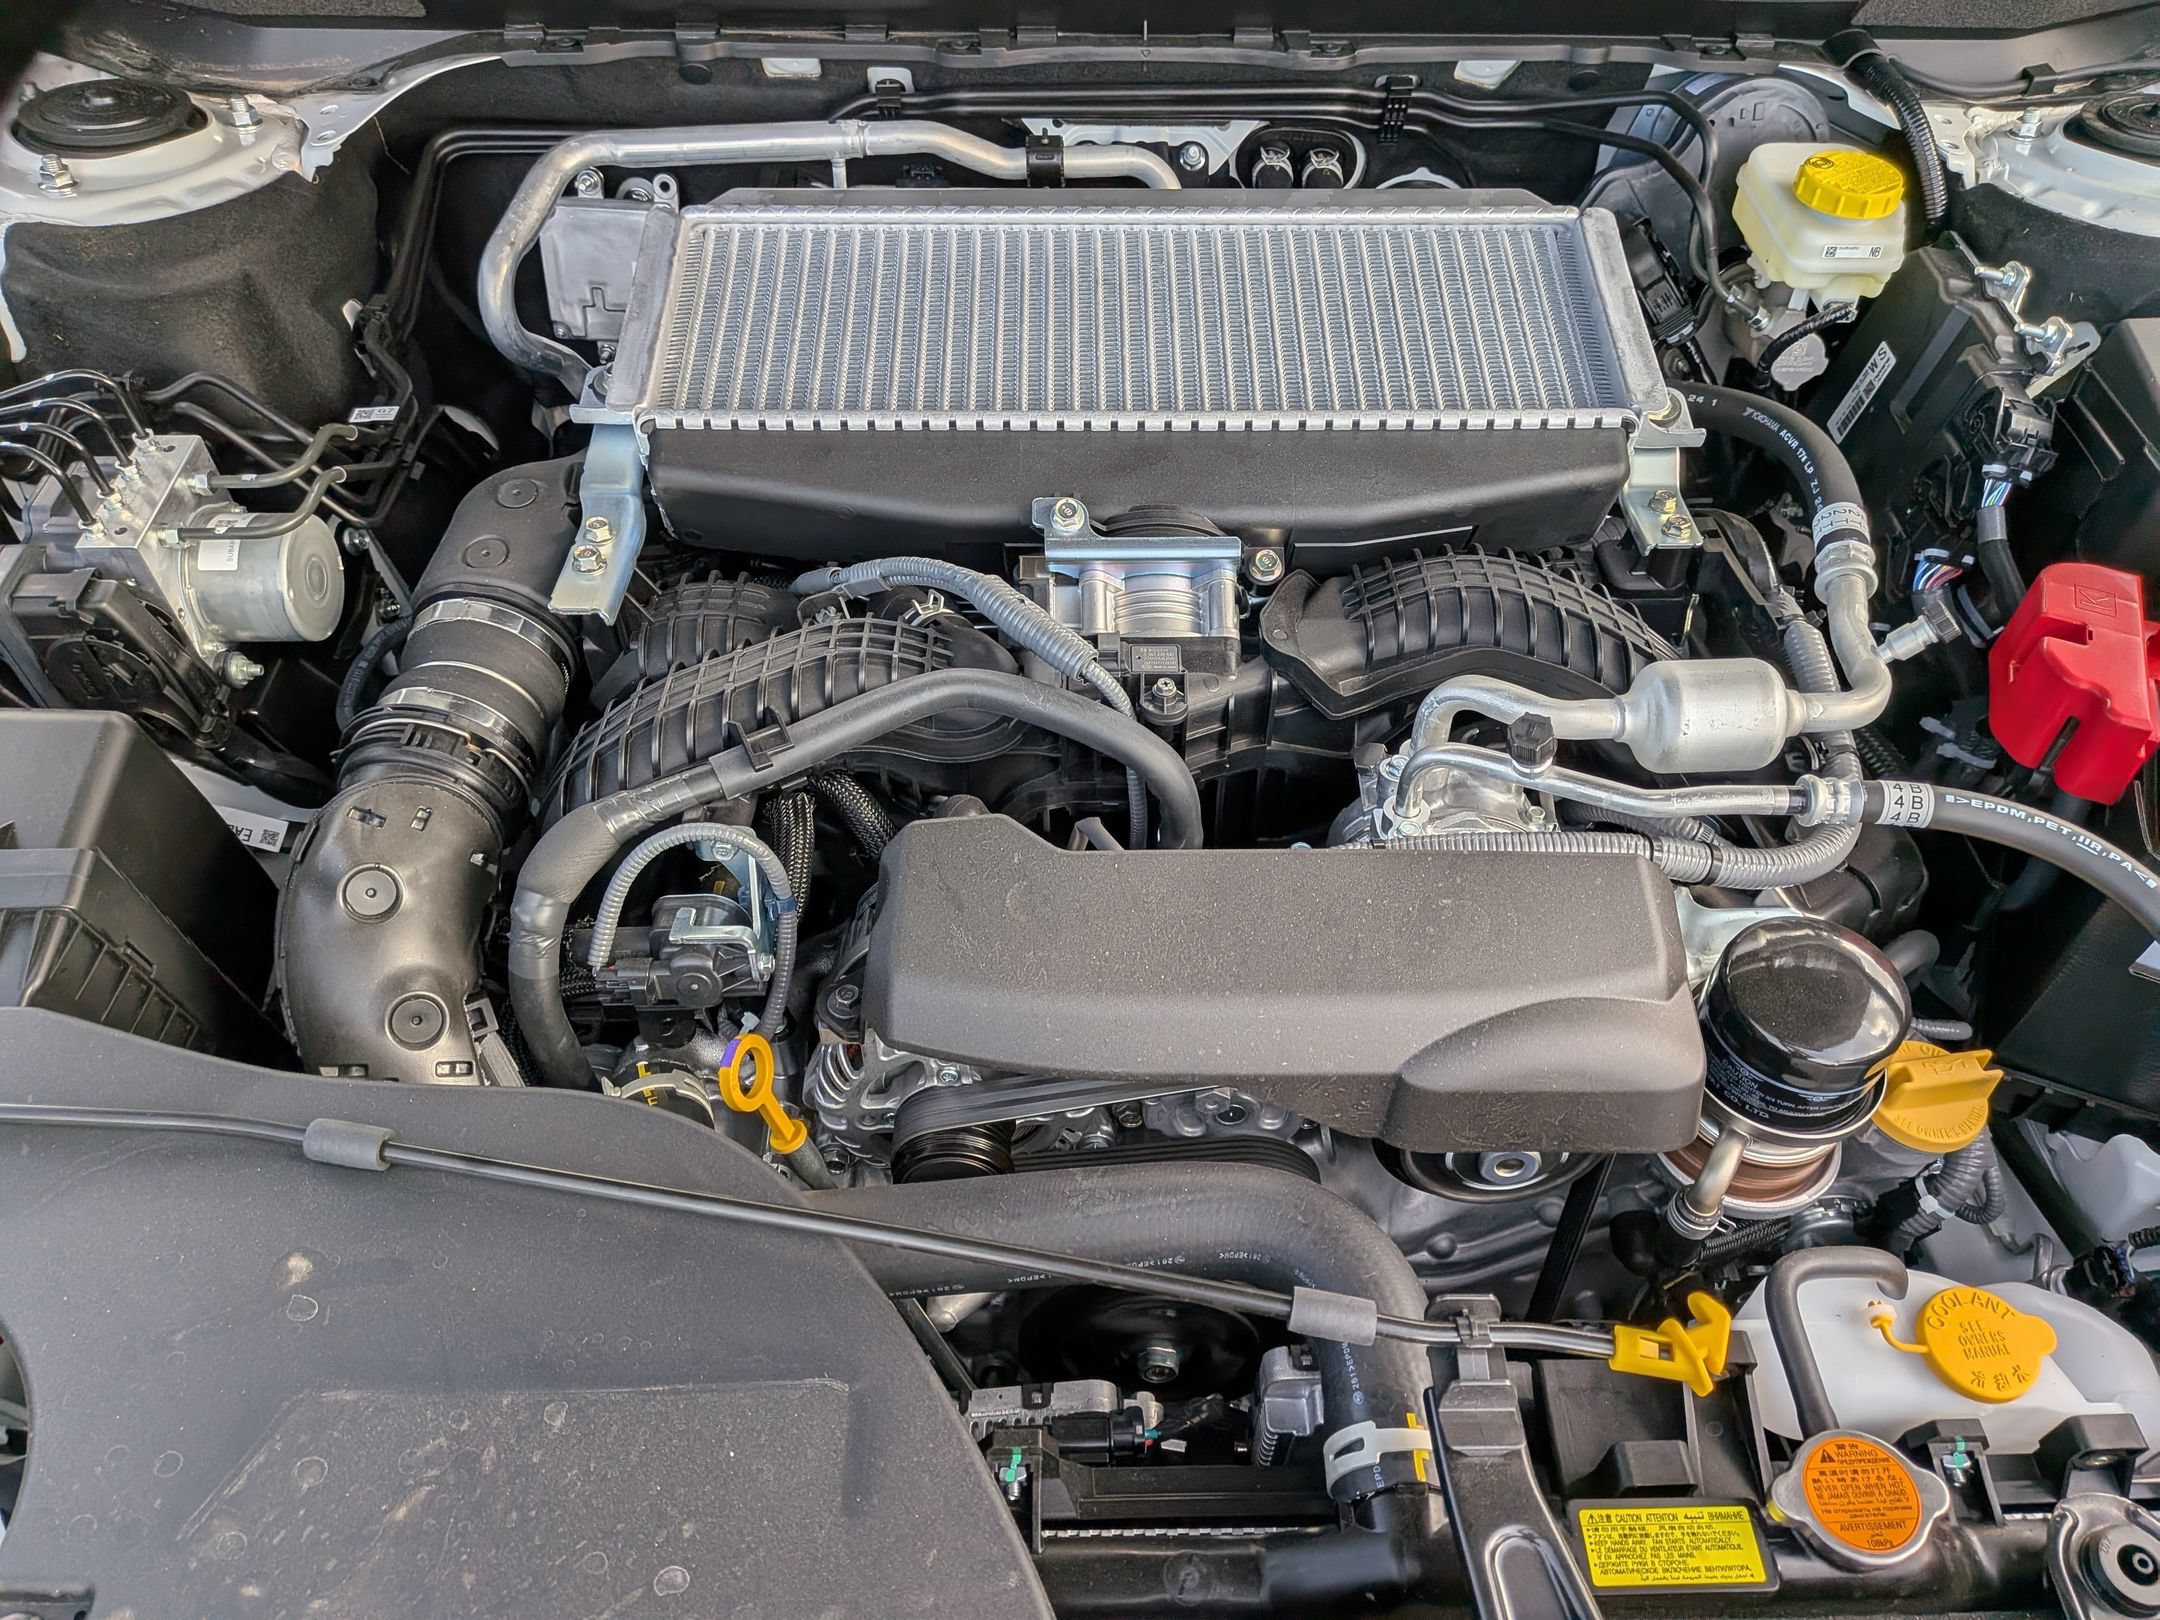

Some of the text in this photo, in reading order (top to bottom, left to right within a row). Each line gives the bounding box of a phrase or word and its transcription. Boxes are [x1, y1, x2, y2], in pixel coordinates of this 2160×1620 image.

[1869, 247, 1881, 258] NB
[1722, 1058, 1759, 1090] CAUTION
[1926, 1291, 2016, 1330] COOLANT
[1960, 1320, 1983, 1334] SEE
[1963, 1344, 2010, 1360] MANUAL
[1835, 1450, 1878, 1458] WARNING
[1813, 1484, 1837, 1493] NEVER
[1840, 1483, 1860, 1492] OPEN
[1864, 1482, 1886, 1491] WHEN
[1828, 1492, 1850, 1500] JAMAIS
[1615, 1513, 1643, 1523] CAUTION
[1646, 1512, 1679, 1522] ATTENTION
[1707, 1511, 1745, 1520] ВНИМАНИЕ
[1840, 1521, 1906, 1532] AVERTISSEMENT
